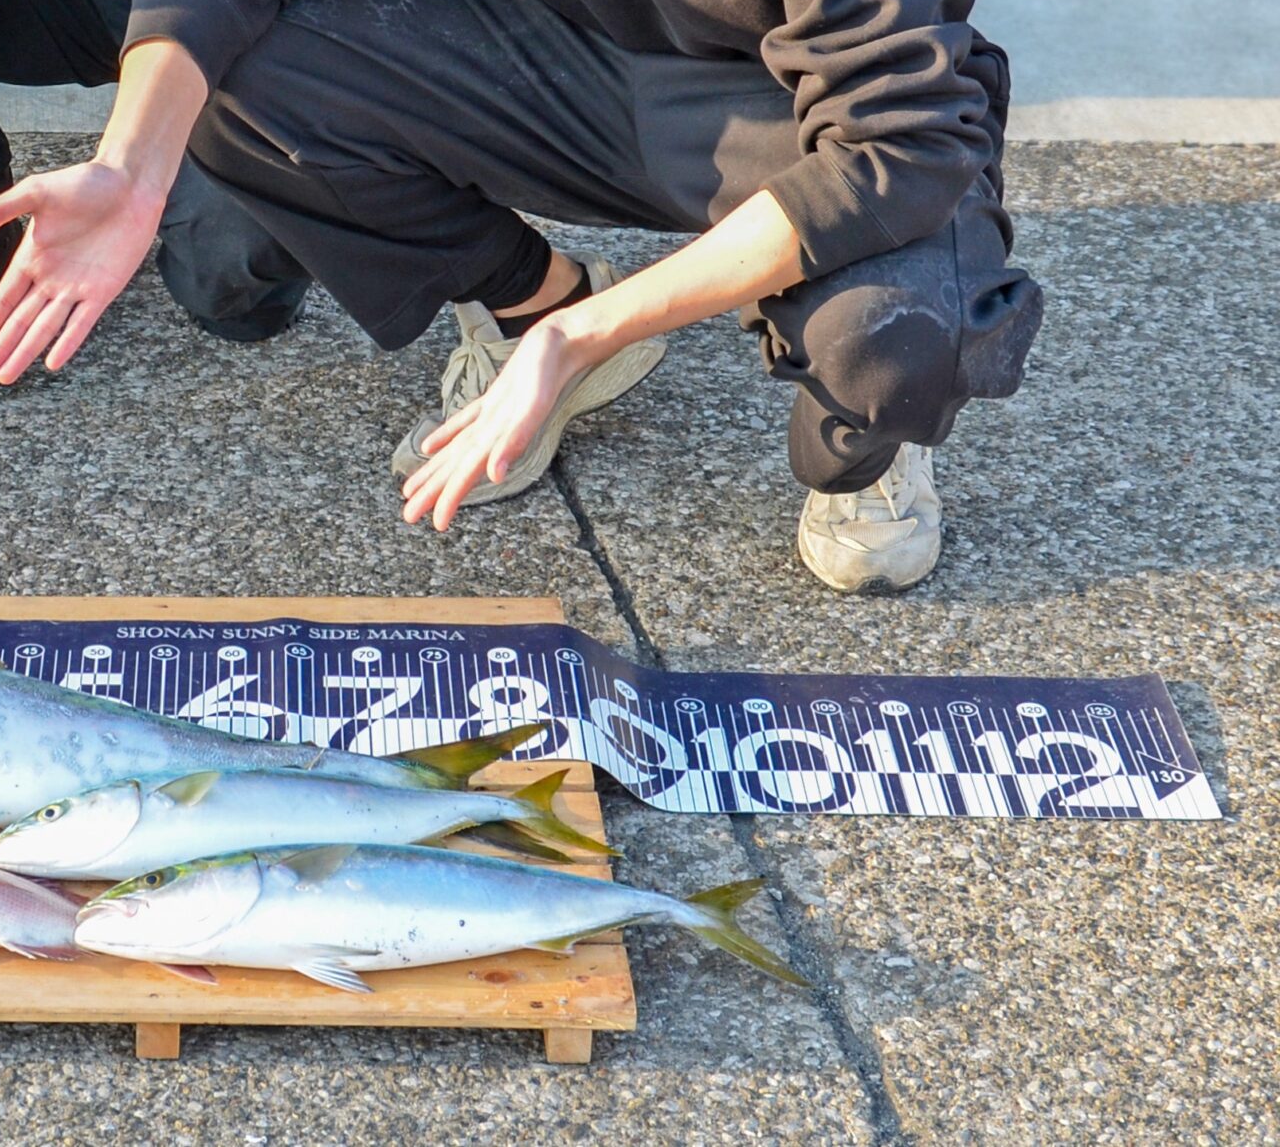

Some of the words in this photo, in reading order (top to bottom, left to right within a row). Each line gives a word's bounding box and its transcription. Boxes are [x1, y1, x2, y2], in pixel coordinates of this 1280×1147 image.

[116, 627, 215, 639] SHONAN
[223, 624, 303, 639] SUNNY
[308, 627, 361, 640] SIDE
[368, 628, 466, 642] MARINA
[22, 646, 38, 656] 45
[90, 648, 106, 656] 50
[157, 648, 173, 657] 55
[224, 648, 241, 658] 60
[291, 645, 308, 655] 65
[358, 650, 375, 659] 70
[426, 651, 443, 660] 75
[495, 651, 510, 660] 80
[562, 651, 578, 662] 85
[682, 701, 698, 710] 95
[747, 701, 768, 710] 100
[816, 703, 837, 712] 105
[884, 704, 905, 712] 110
[952, 705, 973, 714] 115
[1021, 706, 1042, 715] 120
[1089, 707, 1111, 716] 125
[322, 676, 424, 757] 7
[458, 675, 570, 761] 8
[690, 727, 858, 814] 10
[1151, 769, 1186, 784] 130
